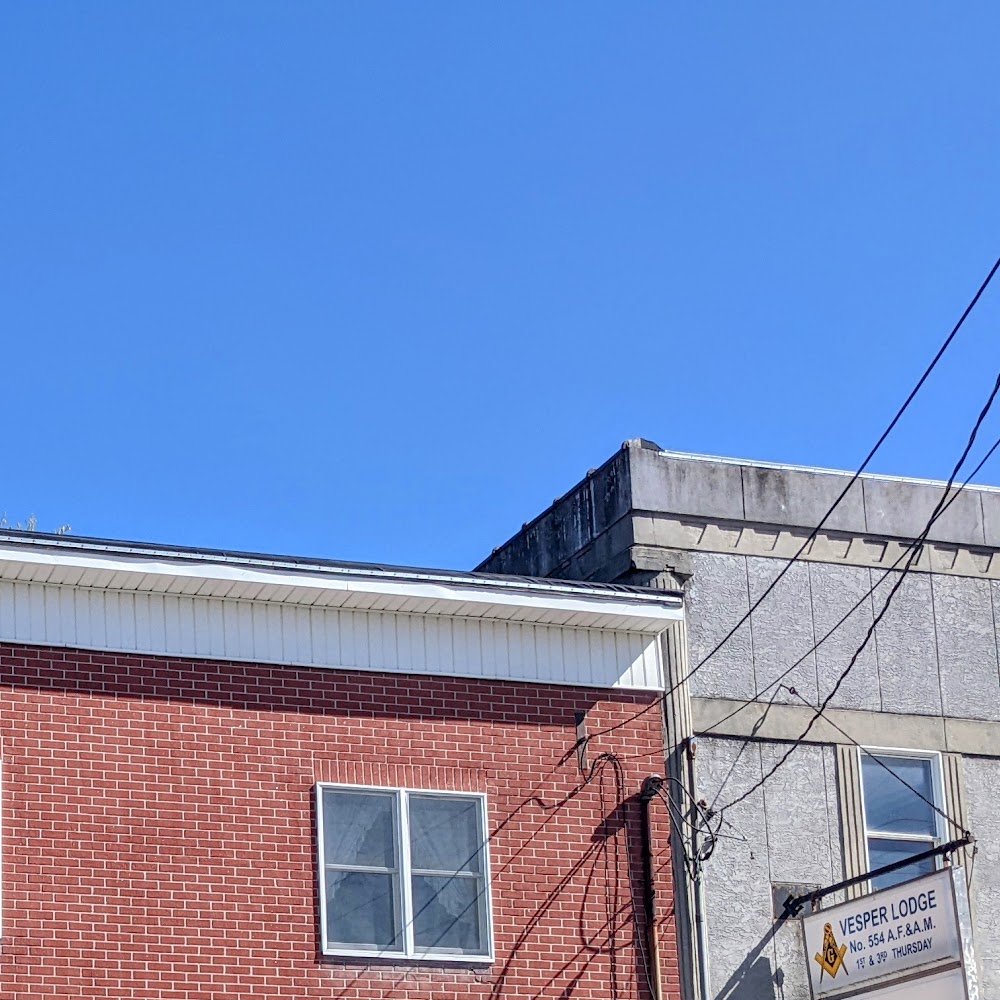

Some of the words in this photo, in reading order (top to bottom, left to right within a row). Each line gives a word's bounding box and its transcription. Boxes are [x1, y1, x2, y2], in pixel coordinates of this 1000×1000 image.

[839, 906, 888, 936] VESPER
[891, 890, 937, 920] LODGE
[849, 940, 866, 953] No.
[868, 932, 885, 948] 554
[887, 917, 936, 943] A.F.&A.M.
[827, 949, 835, 964] G
[869, 955, 875, 966] &
[892, 937, 933, 959] THURSDAY
